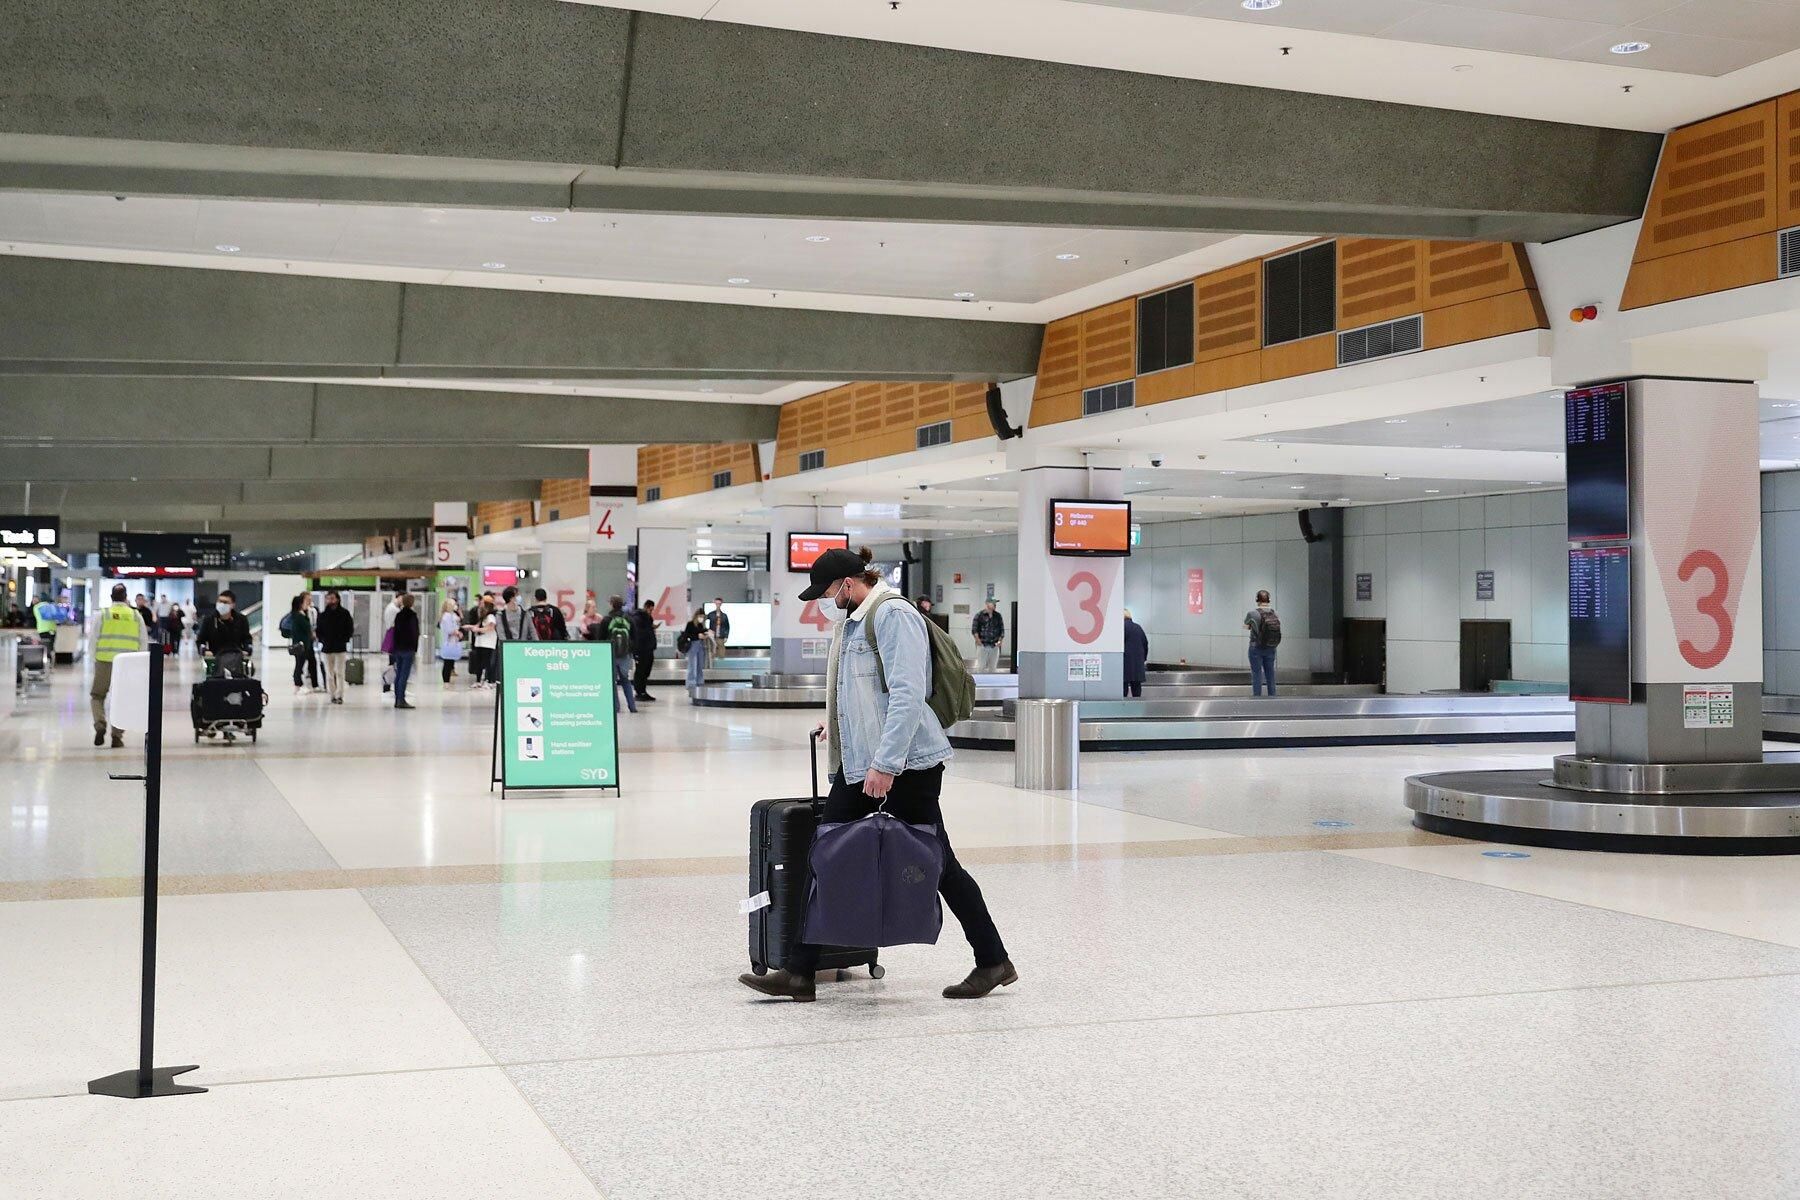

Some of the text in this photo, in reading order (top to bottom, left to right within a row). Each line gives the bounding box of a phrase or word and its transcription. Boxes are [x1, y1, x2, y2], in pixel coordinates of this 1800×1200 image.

[596, 509, 615, 540] 4
[1055, 512, 1064, 526] 3
[438, 541, 450, 562] 5
[791, 541, 800, 552] 4
[556, 590, 576, 623] 5
[654, 586, 676, 627] 4
[1066, 571, 1105, 644] 3
[1677, 549, 1733, 670] 3
[799, 599, 834, 632] 4
[524, 646, 591, 659] Keeping you
[546, 660, 570, 671] safe
[549, 684, 568, 692] Hourly
[569, 684, 593, 692] cleaning
[550, 711, 594, 719] Hospital-grade
[551, 719, 603, 727] cleaning products
[580, 768, 608, 780] SYD
